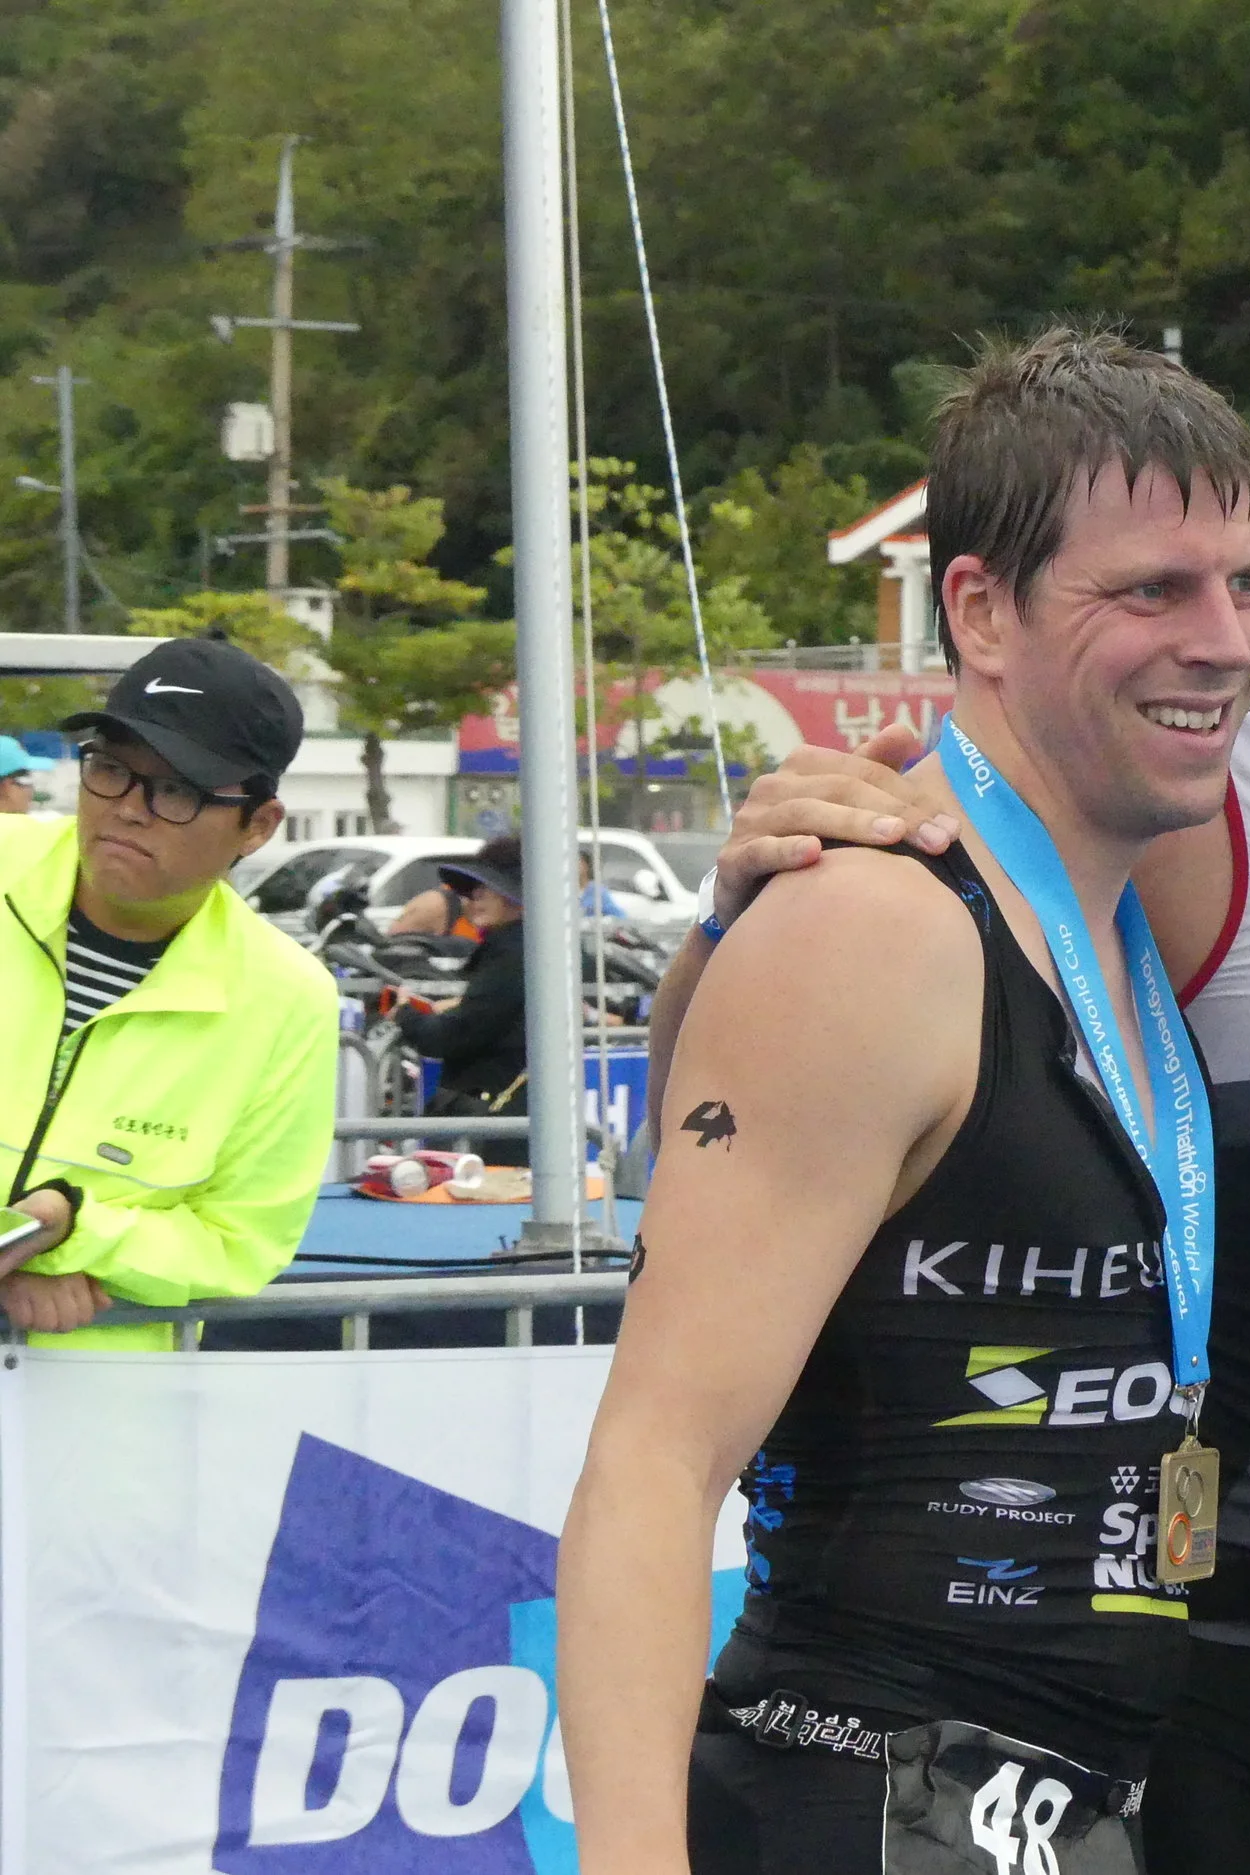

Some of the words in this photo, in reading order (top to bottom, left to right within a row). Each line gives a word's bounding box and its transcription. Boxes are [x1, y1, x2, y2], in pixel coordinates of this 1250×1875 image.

[1058, 923, 1079, 970] Cup
[1072, 975, 1106, 1042] World
[1139, 947, 1181, 1074] Tongyeong
[1182, 1202, 1200, 1272] World
[927, 1501, 988, 1517] RUDY
[995, 1507, 1076, 1526] PROJECT
[947, 1581, 1046, 1606] EINZ
[969, 1760, 1074, 1875] 48
